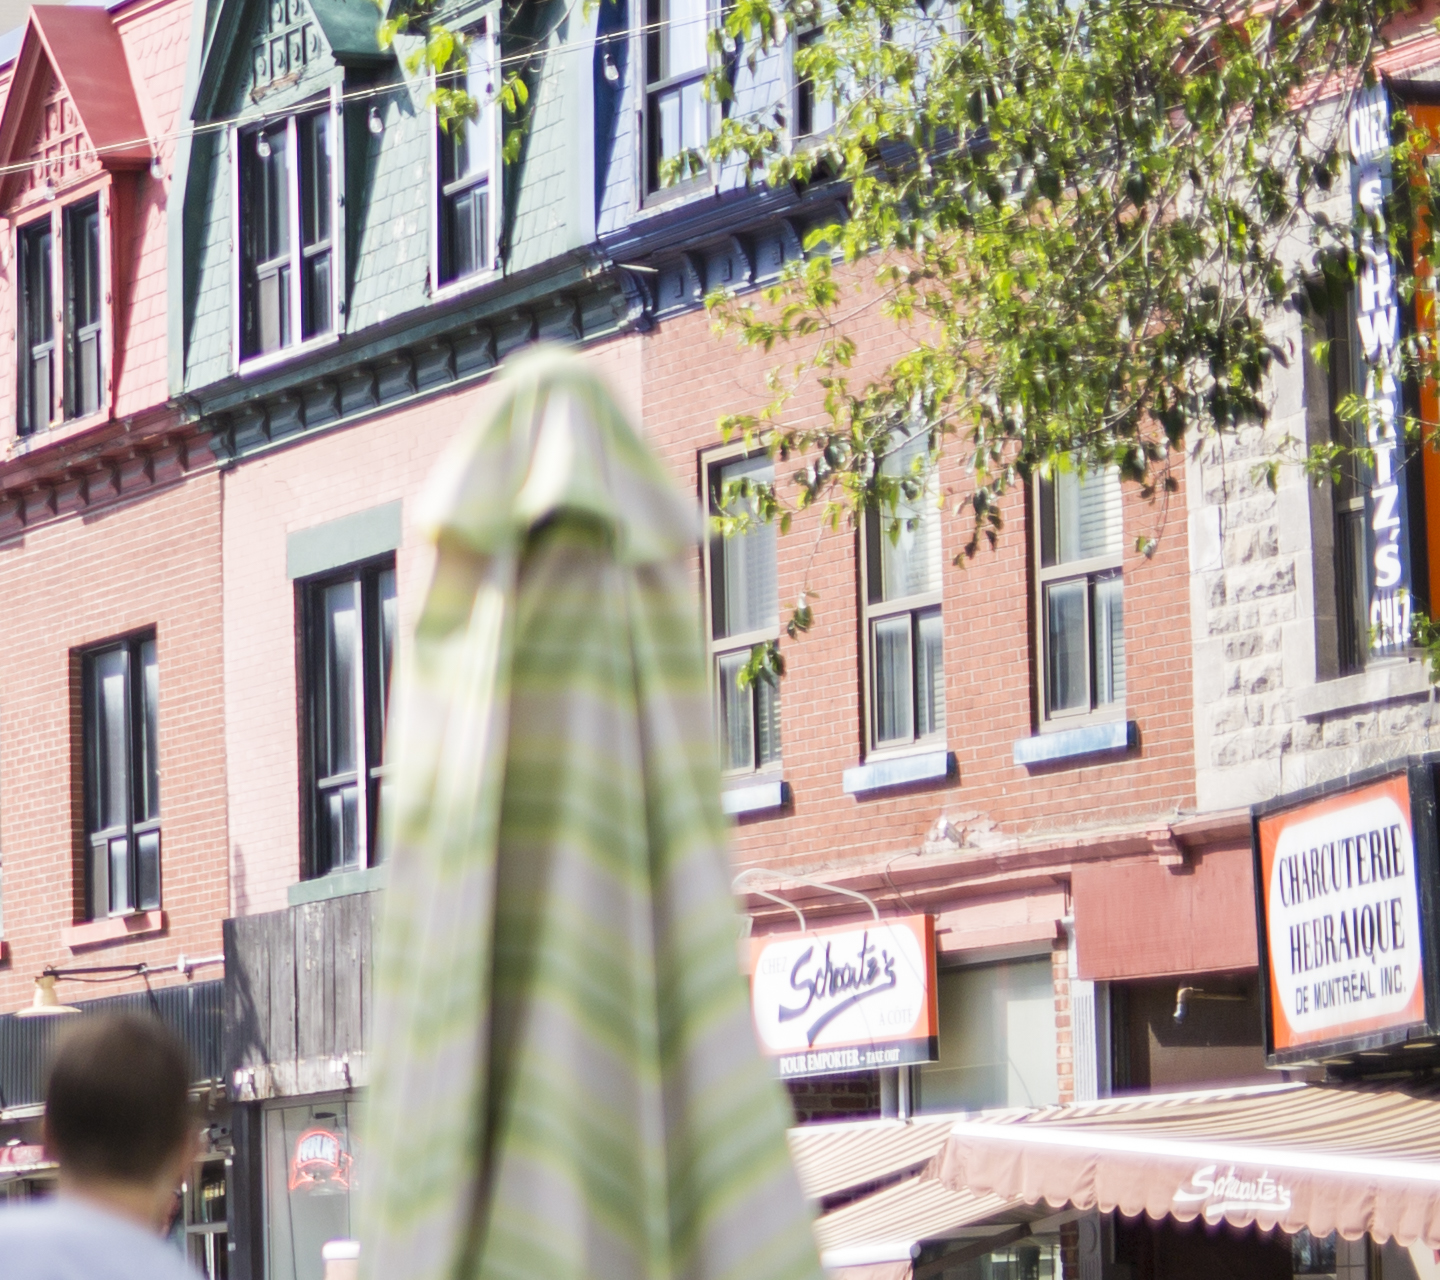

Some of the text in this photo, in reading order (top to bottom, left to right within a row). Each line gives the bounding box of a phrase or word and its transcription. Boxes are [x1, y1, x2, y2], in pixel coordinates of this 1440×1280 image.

[1279, 822, 1406, 909] CHARCUTERIE
[1289, 897, 1406, 976] HEBRAIQUE
[778, 931, 897, 1032] Schwartz's
[1295, 964, 1407, 1016] DE MONTRÉAL INC.
[780, 1056, 807, 1075] POUR
[807, 1048, 860, 1070] EMPORTER
[884, 1048, 901, 1063] OUT
[1172, 1164, 1292, 1210] Schwartz's
